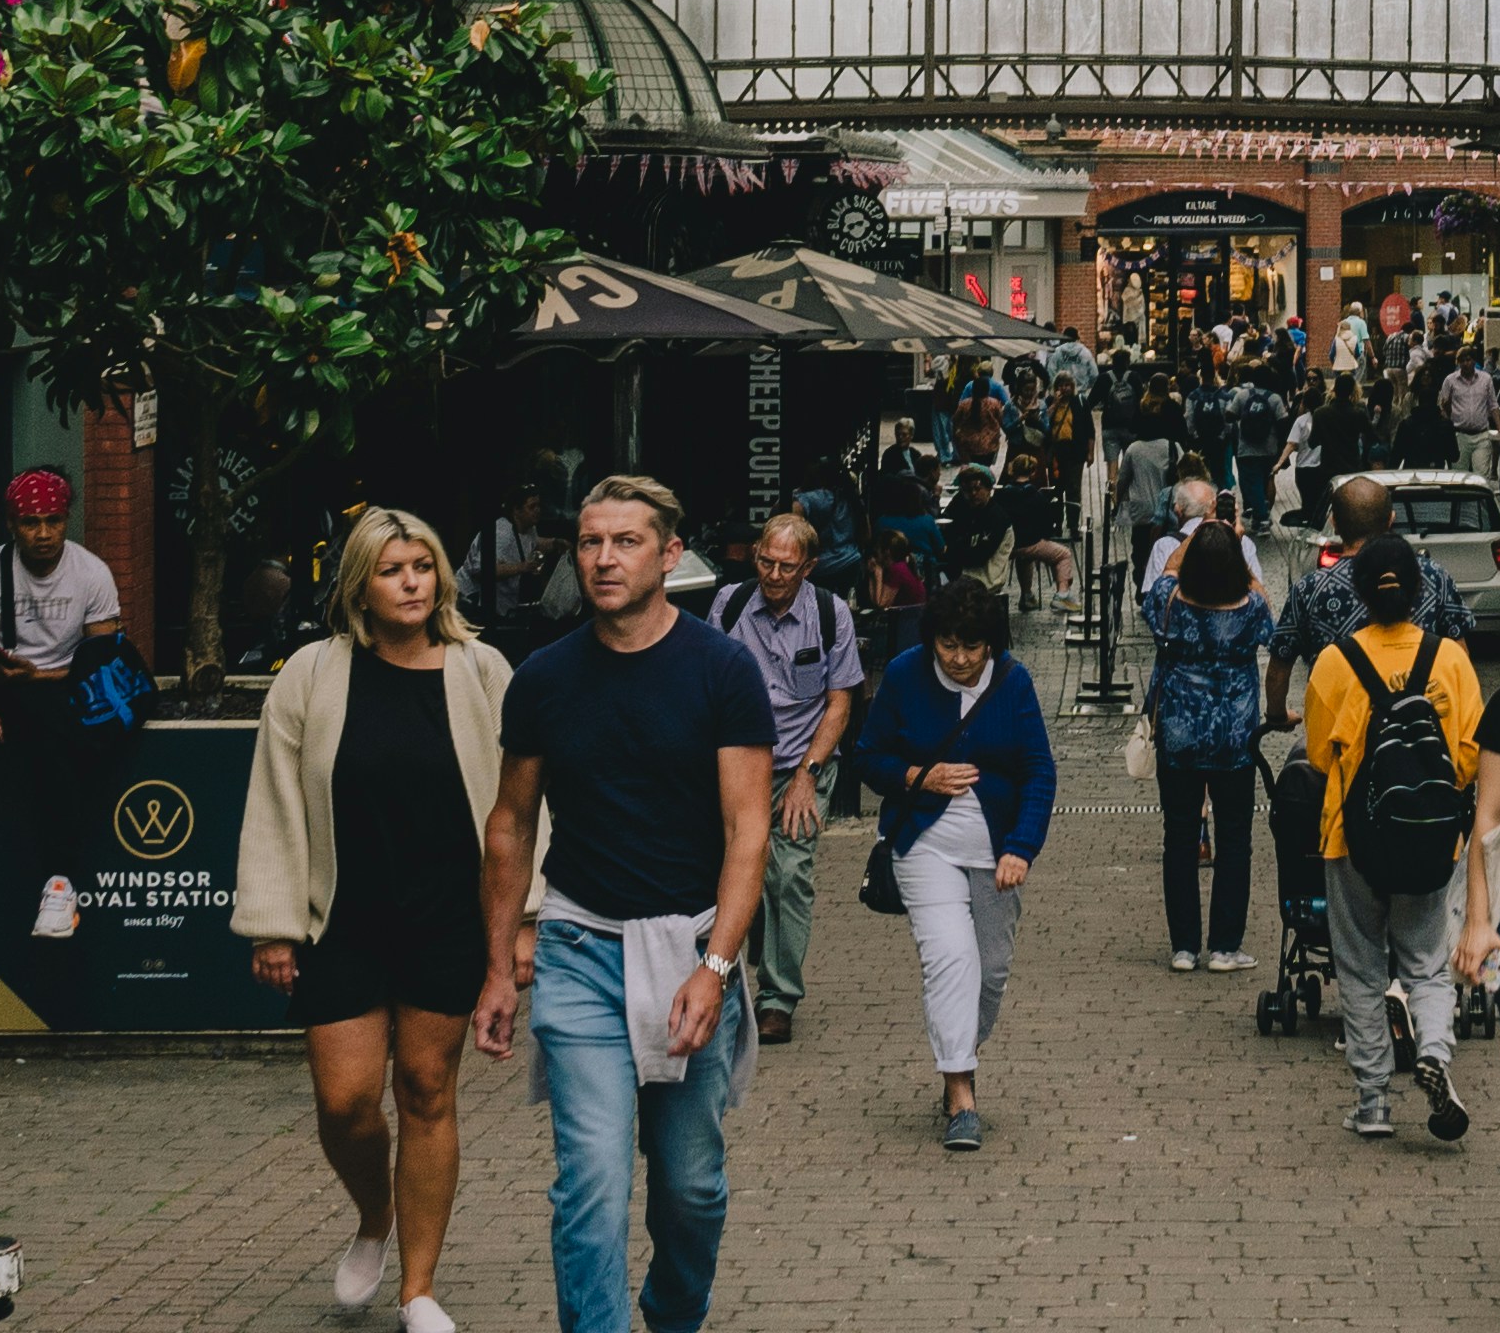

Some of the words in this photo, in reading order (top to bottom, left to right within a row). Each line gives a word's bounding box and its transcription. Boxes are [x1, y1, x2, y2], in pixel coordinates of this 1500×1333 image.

[827, 196, 852, 230] BLACK
[853, 194, 884, 220] SHEEP
[886, 191, 946, 215] FIVE
[948, 191, 1021, 215] GUYS
[1381, 207, 1435, 223] JIGSA
[1153, 215, 1170, 225] FINE
[1172, 214, 1209, 224] WOOLLENS
[1218, 214, 1246, 224] TWEEDS
[839, 230, 882, 254] COFFEE
[749, 350, 781, 430] SHEEP
[213, 447, 257, 482] SHEE
[749, 437, 781, 529] COFFE
[96, 871, 211, 888] WINDSOR
[77, 890, 138, 908] OYAL
[123, 917, 153, 927] SINCE
[155, 913, 186, 930] 1897
